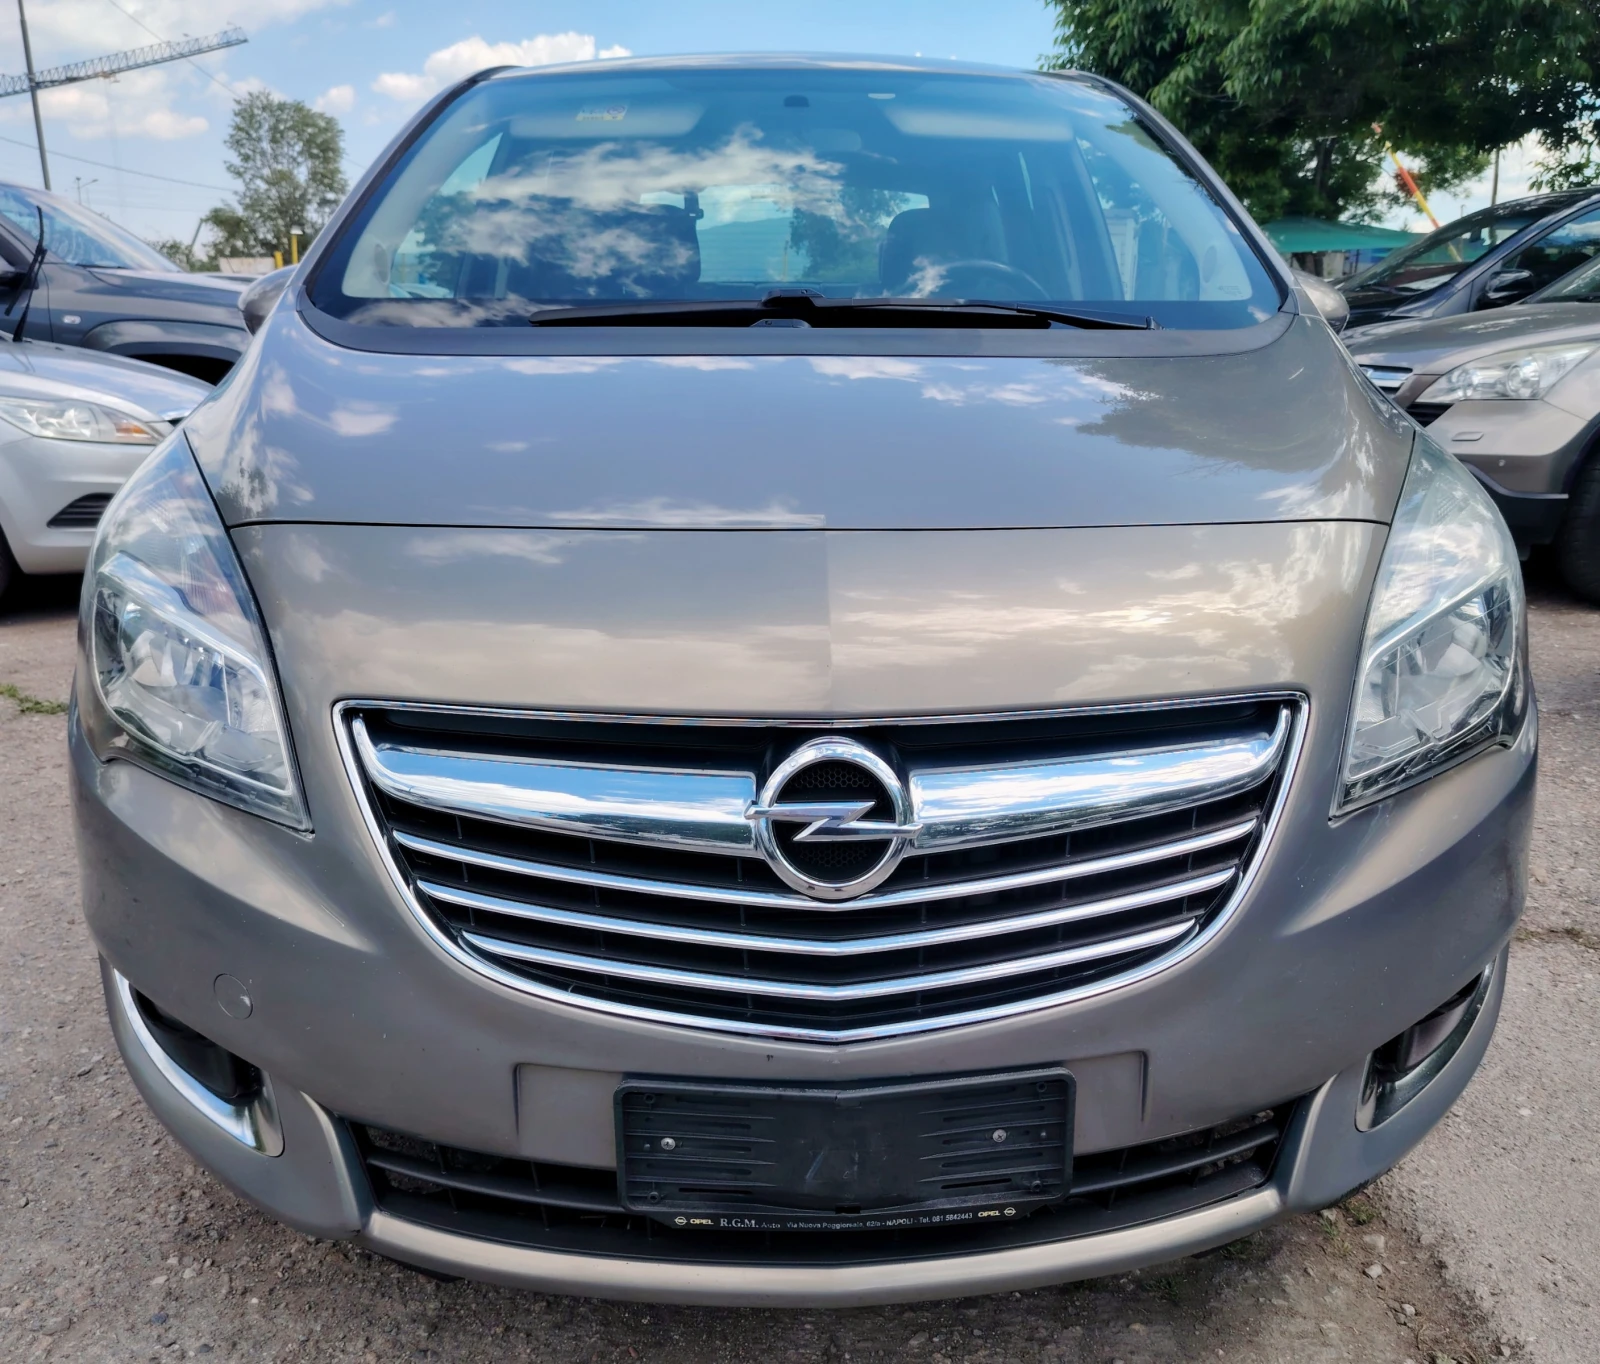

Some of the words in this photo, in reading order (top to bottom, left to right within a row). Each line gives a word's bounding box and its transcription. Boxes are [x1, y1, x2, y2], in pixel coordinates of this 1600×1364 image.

[719, 1218, 759, 1228] R.G.M.
[886, 1217, 914, 1226] NAPOLI
[919, 1216, 931, 1224] Tel.
[945, 1212, 973, 1221] 5842443
[977, 1210, 1001, 1218] OPEL
